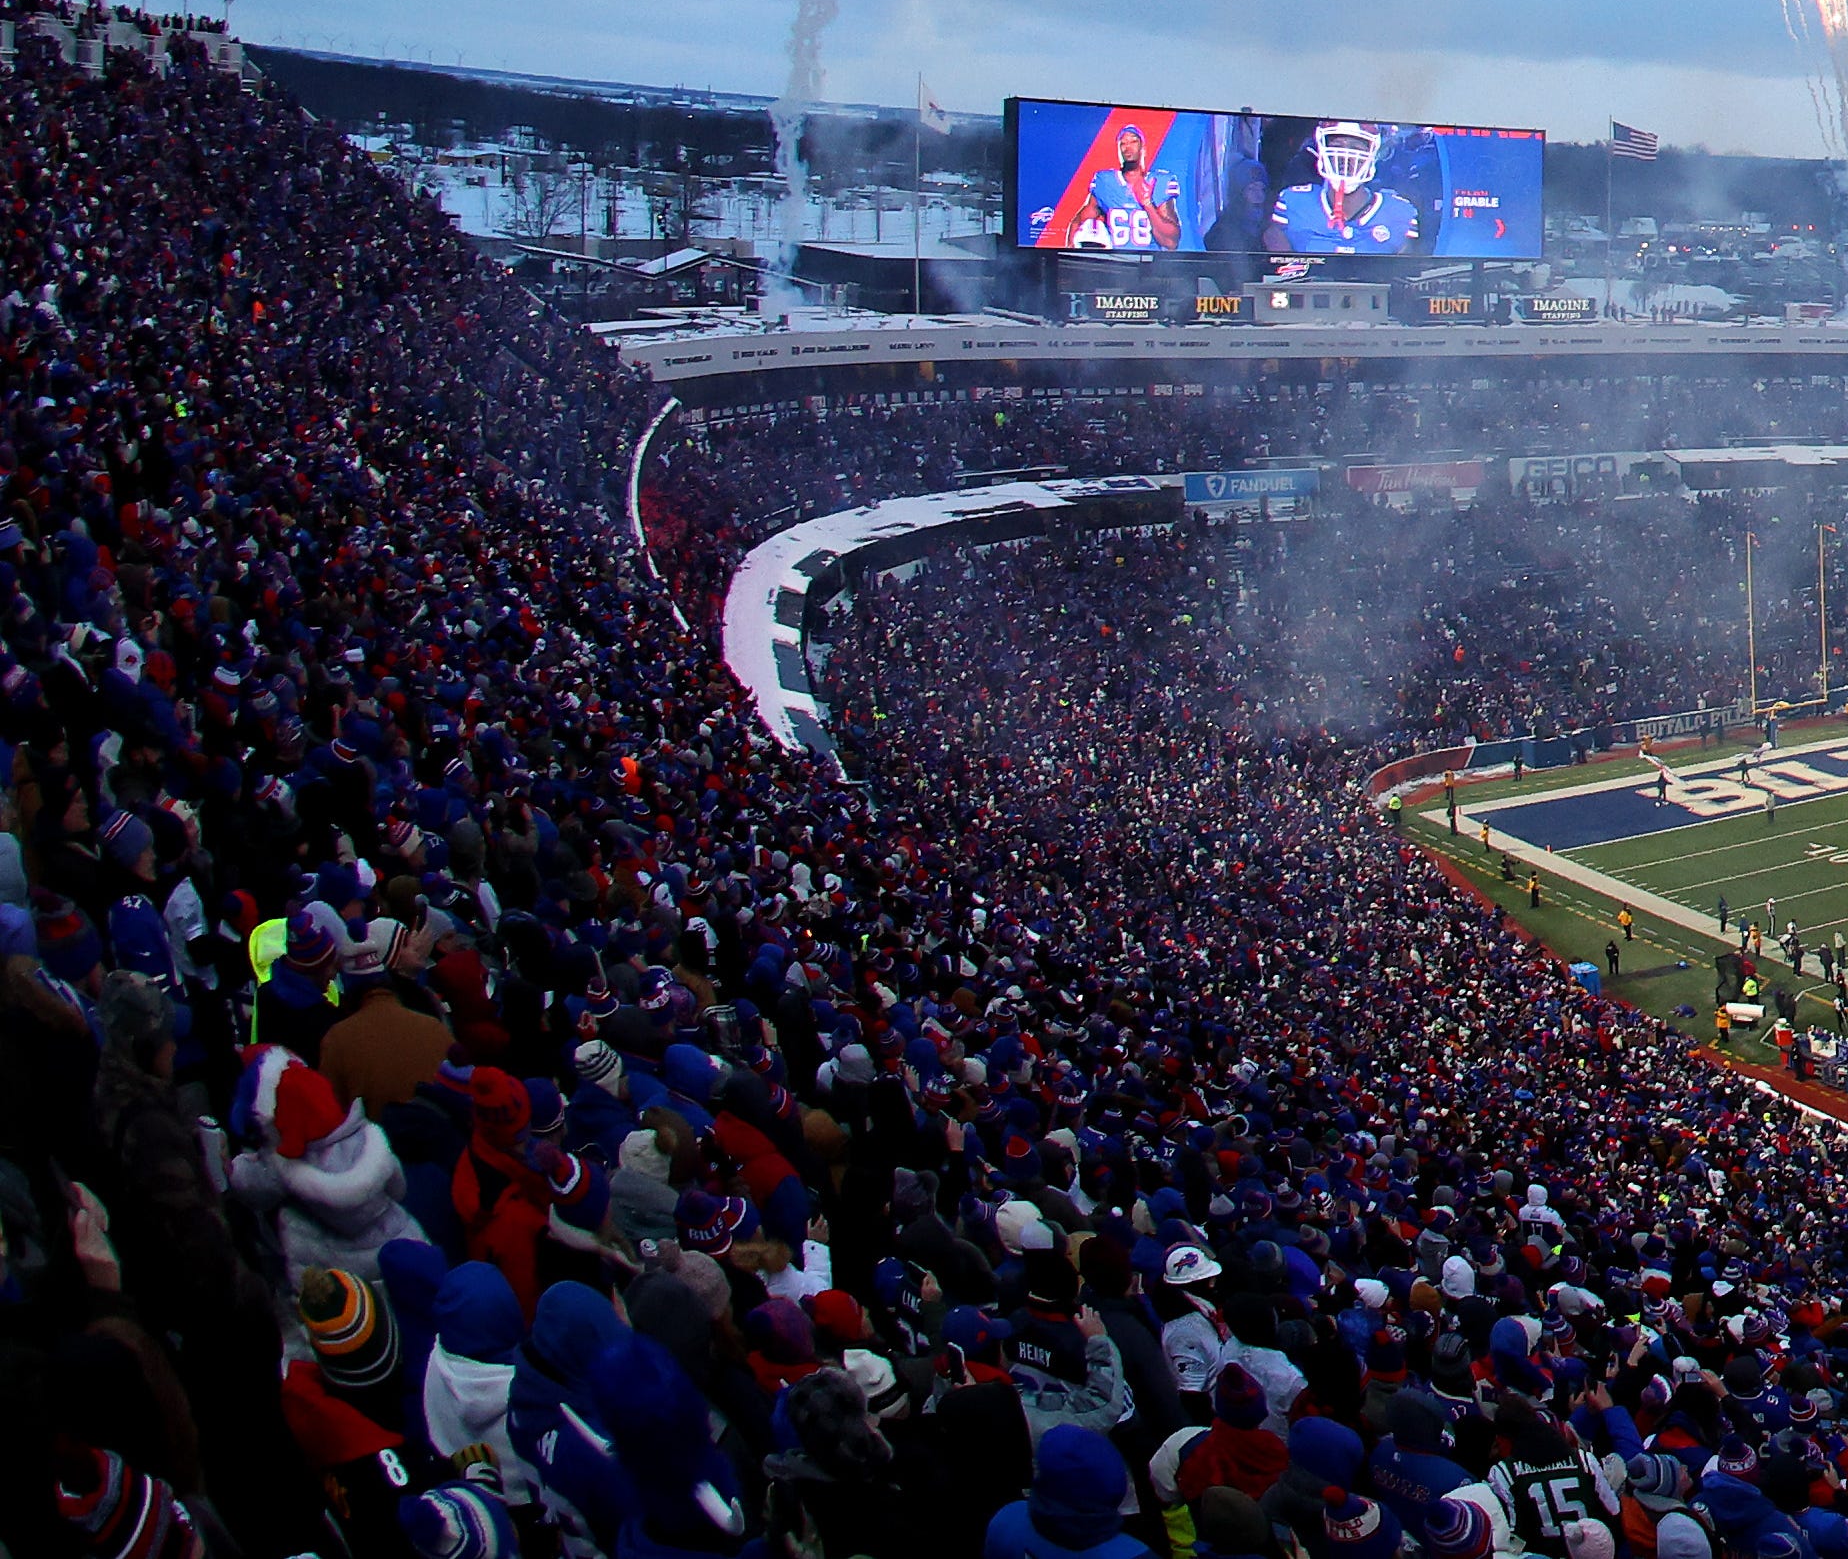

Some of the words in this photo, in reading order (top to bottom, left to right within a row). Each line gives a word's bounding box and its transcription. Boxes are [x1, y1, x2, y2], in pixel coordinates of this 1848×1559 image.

[1454, 197, 1499, 208] GRABLE
[1109, 208, 1152, 246] 68
[1096, 296, 1160, 309] IMAGINE
[1196, 297, 1242, 314] HUNT
[1429, 299, 1471, 315] HUNT
[1533, 299, 1589, 312] IMAGINE
[1527, 455, 1617, 478] GEICO
[1230, 476, 1296, 493] FANDUEL
[379, 1448, 409, 1487] 8
[1528, 1477, 1589, 1538] 15
